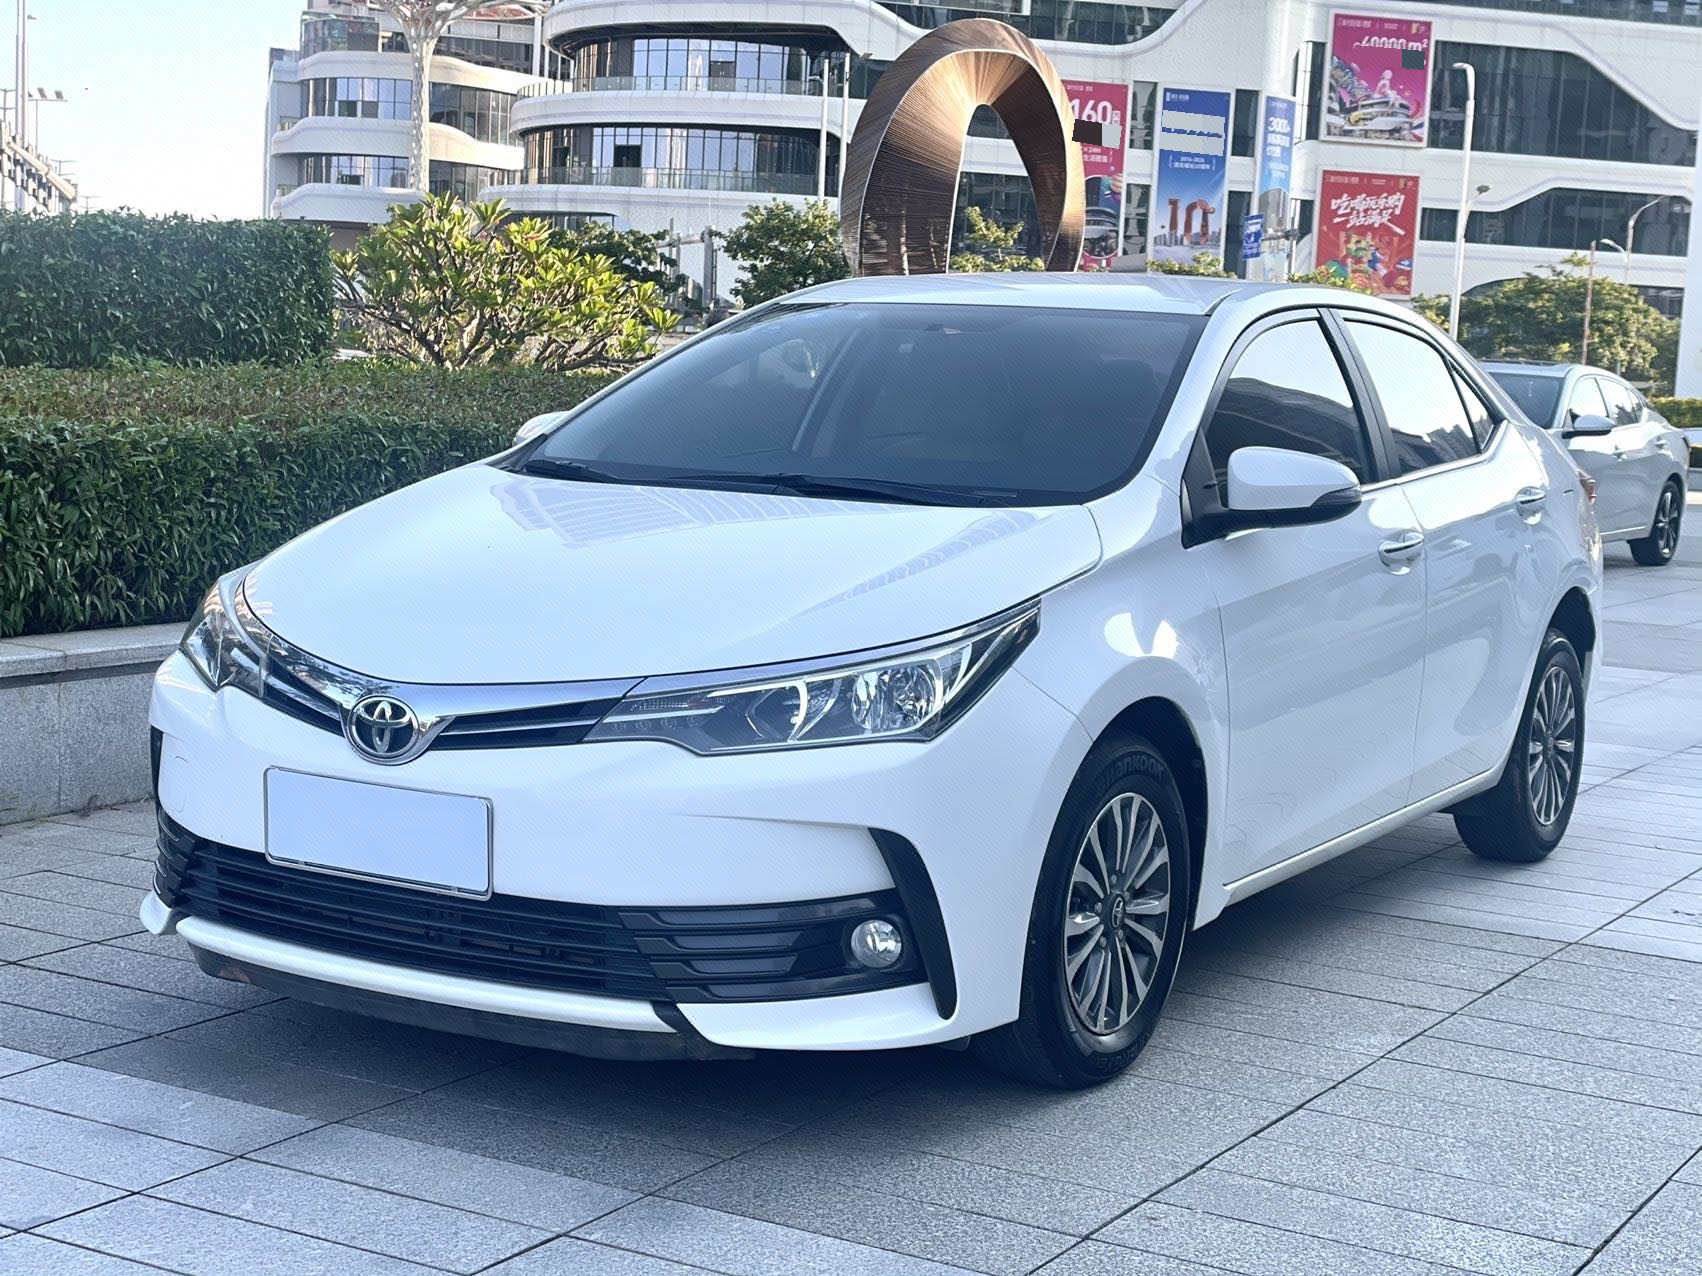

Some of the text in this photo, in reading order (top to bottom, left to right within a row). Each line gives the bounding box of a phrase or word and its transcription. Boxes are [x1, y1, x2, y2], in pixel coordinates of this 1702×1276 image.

[1330, 191, 1405, 215] 吃喝玩乐购
[1332, 209, 1406, 236] 一站满足
